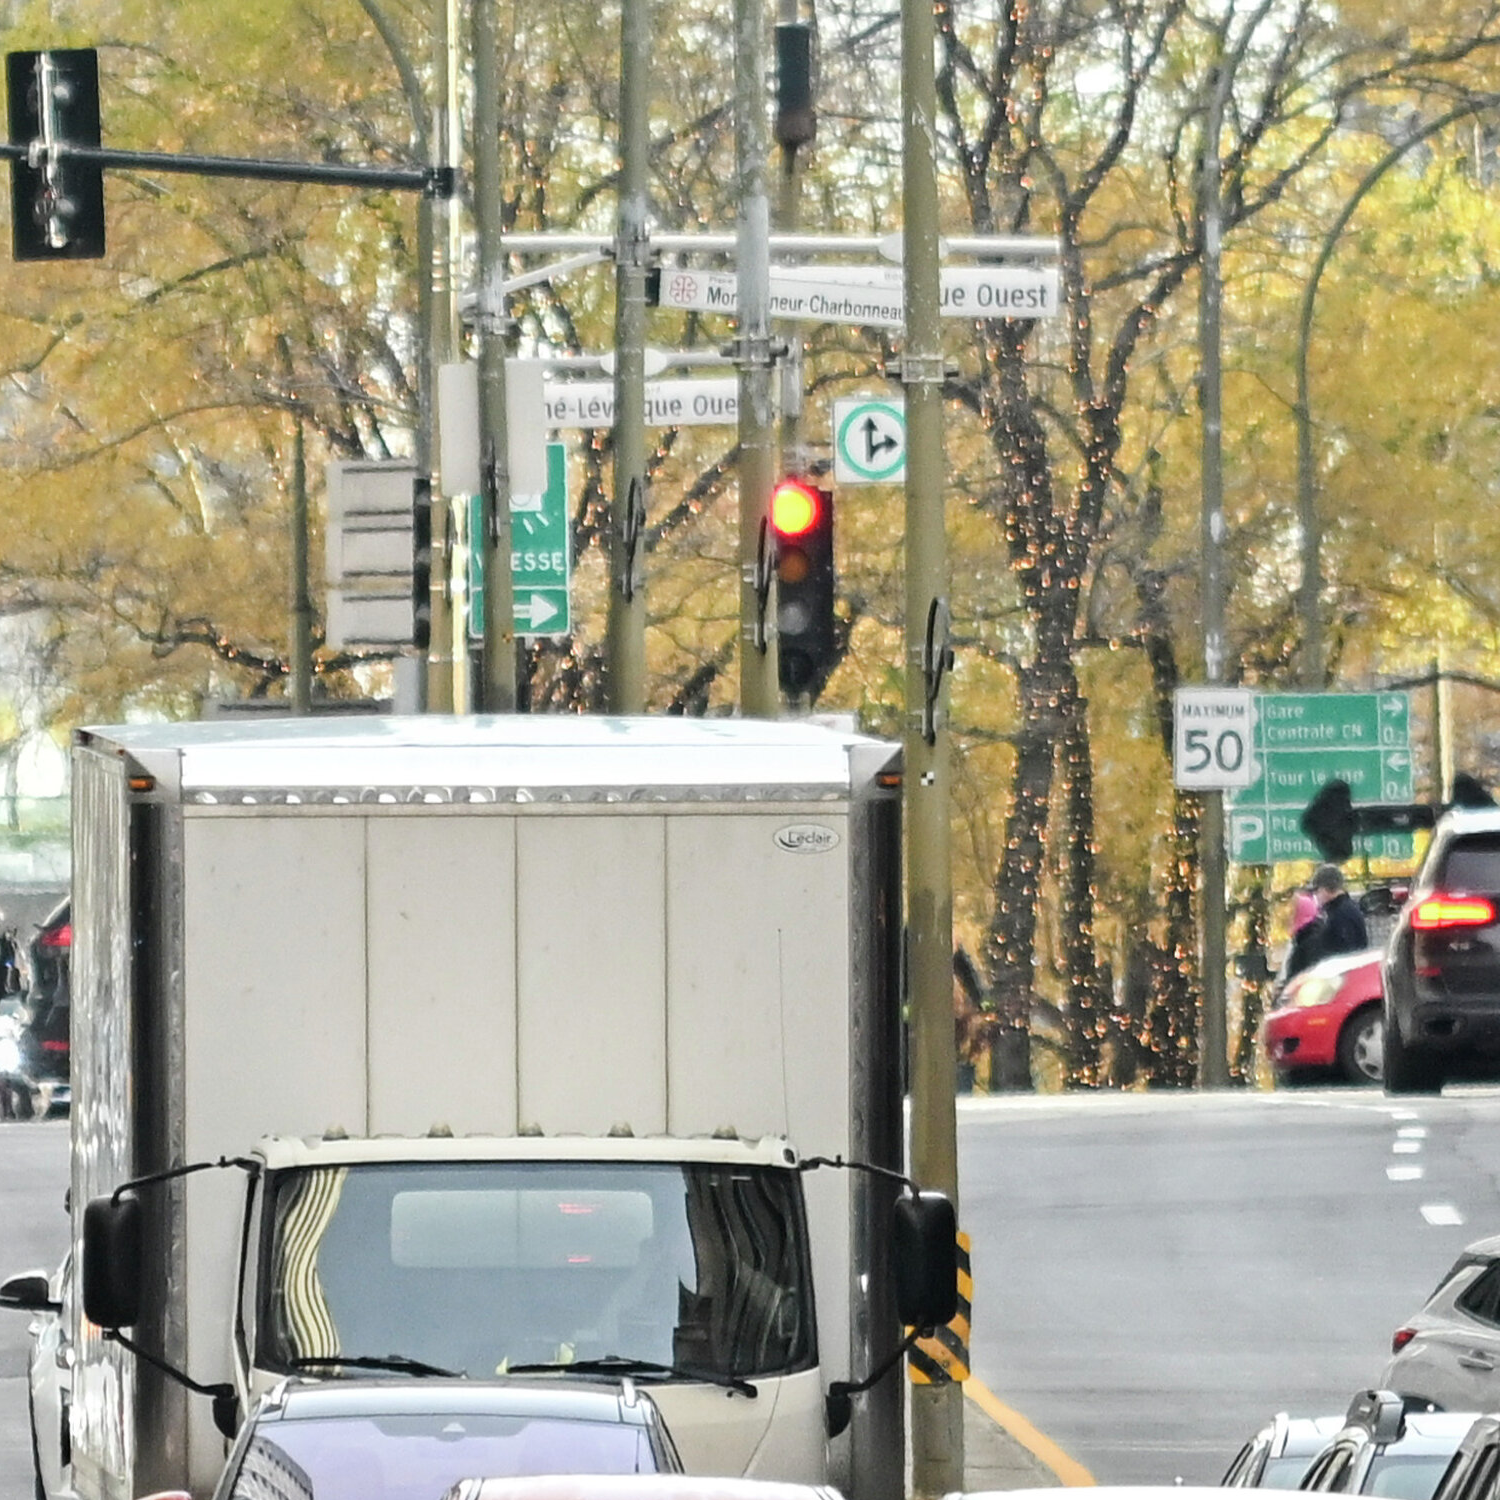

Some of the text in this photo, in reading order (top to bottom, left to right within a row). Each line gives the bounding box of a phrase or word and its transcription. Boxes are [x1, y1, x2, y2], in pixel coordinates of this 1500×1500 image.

[707, 286, 902, 320] Moneur-Charbonnea
[977, 284, 1047, 308] Ouest
[544, 394, 736, 423] né-Lévque Oue
[1181, 704, 1245, 719] MAXIMUM
[1267, 704, 1305, 719] Gare
[1267, 724, 1335, 741] Centrale
[1184, 729, 1244, 773] 50
[1270, 771, 1304, 786] Tour
[1311, 769, 1326, 785] le
[1232, 816, 1297, 855] P Pla
